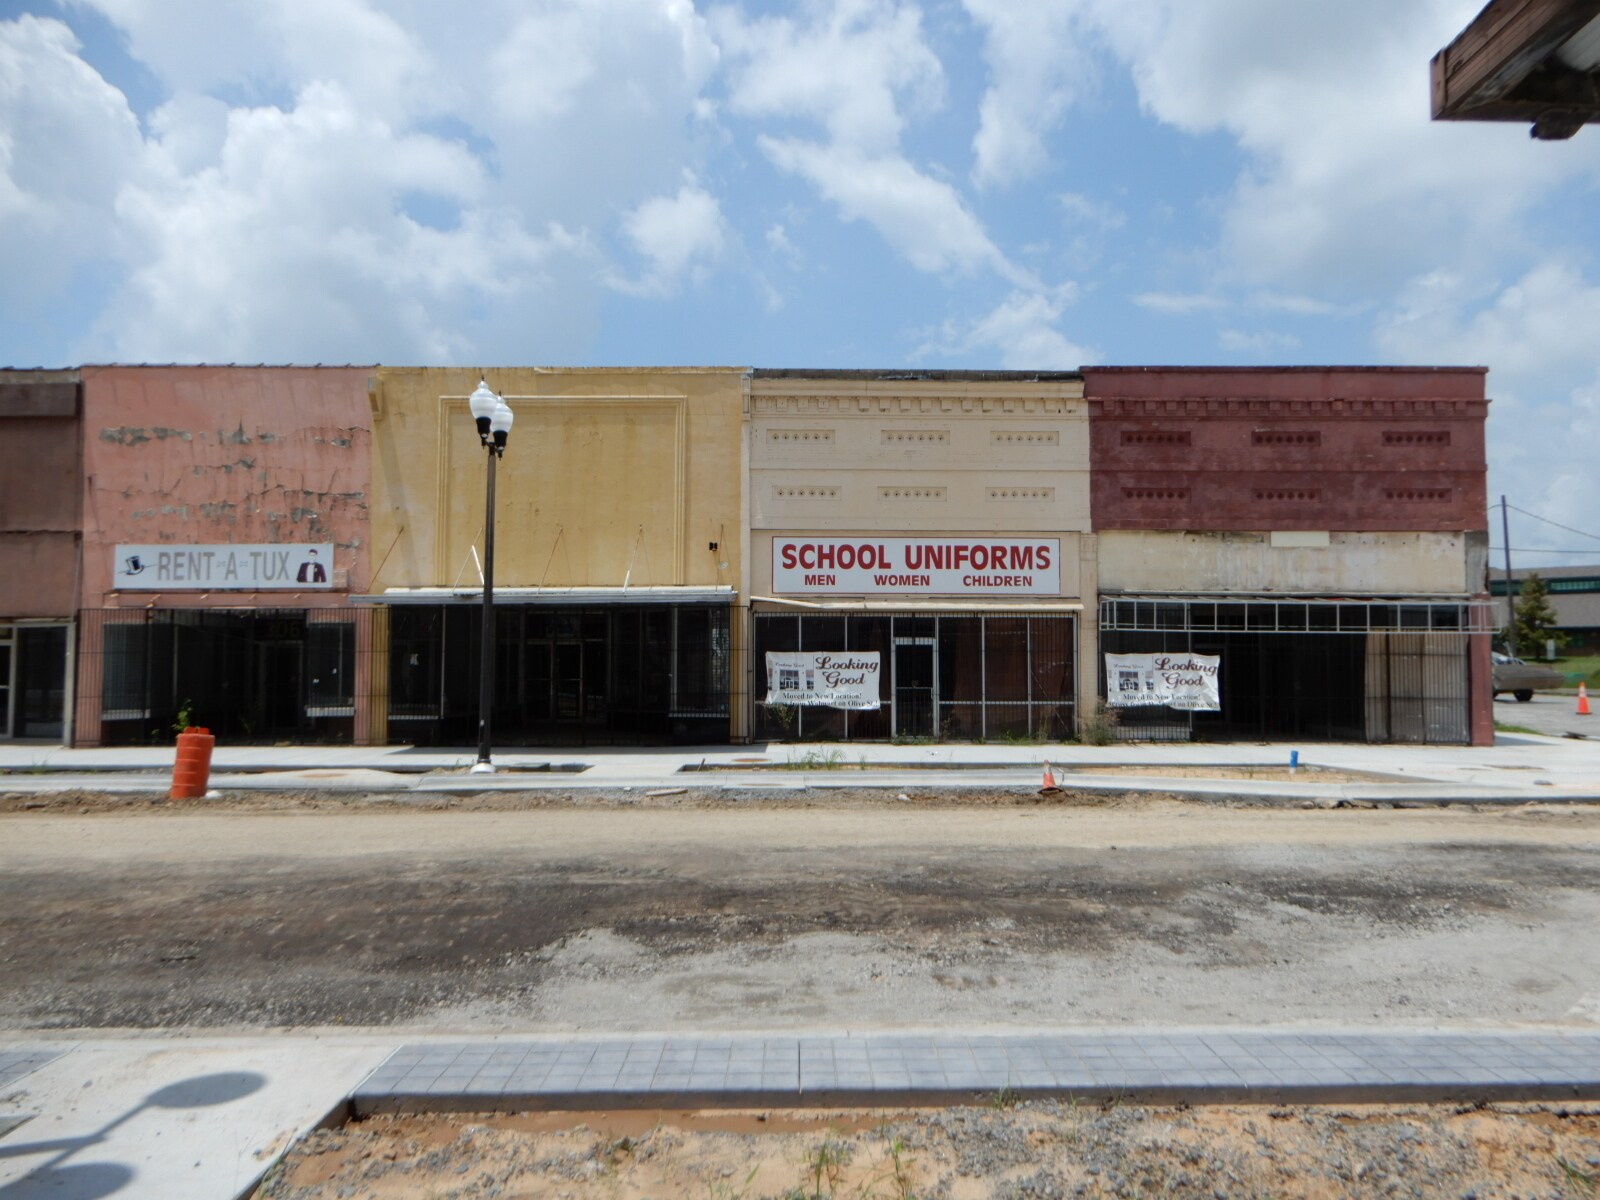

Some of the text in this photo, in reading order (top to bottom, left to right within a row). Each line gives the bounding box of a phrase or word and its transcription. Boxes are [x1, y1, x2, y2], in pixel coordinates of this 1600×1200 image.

[781, 543, 1051, 571] SCHOOL UNIFORMS
[804, 574, 1033, 587] MEN WOMEN CHILDREN
[815, 655, 879, 673] Looking
[1155, 657, 1218, 676] Looking
[822, 671, 866, 689] Good
[1161, 672, 1204, 689] Good
[783, 692, 805, 700] Moved
[806, 692, 814, 700] to
[830, 692, 862, 700] Location!
[1122, 693, 1145, 701] Moved
[1146, 693, 1154, 701] to
